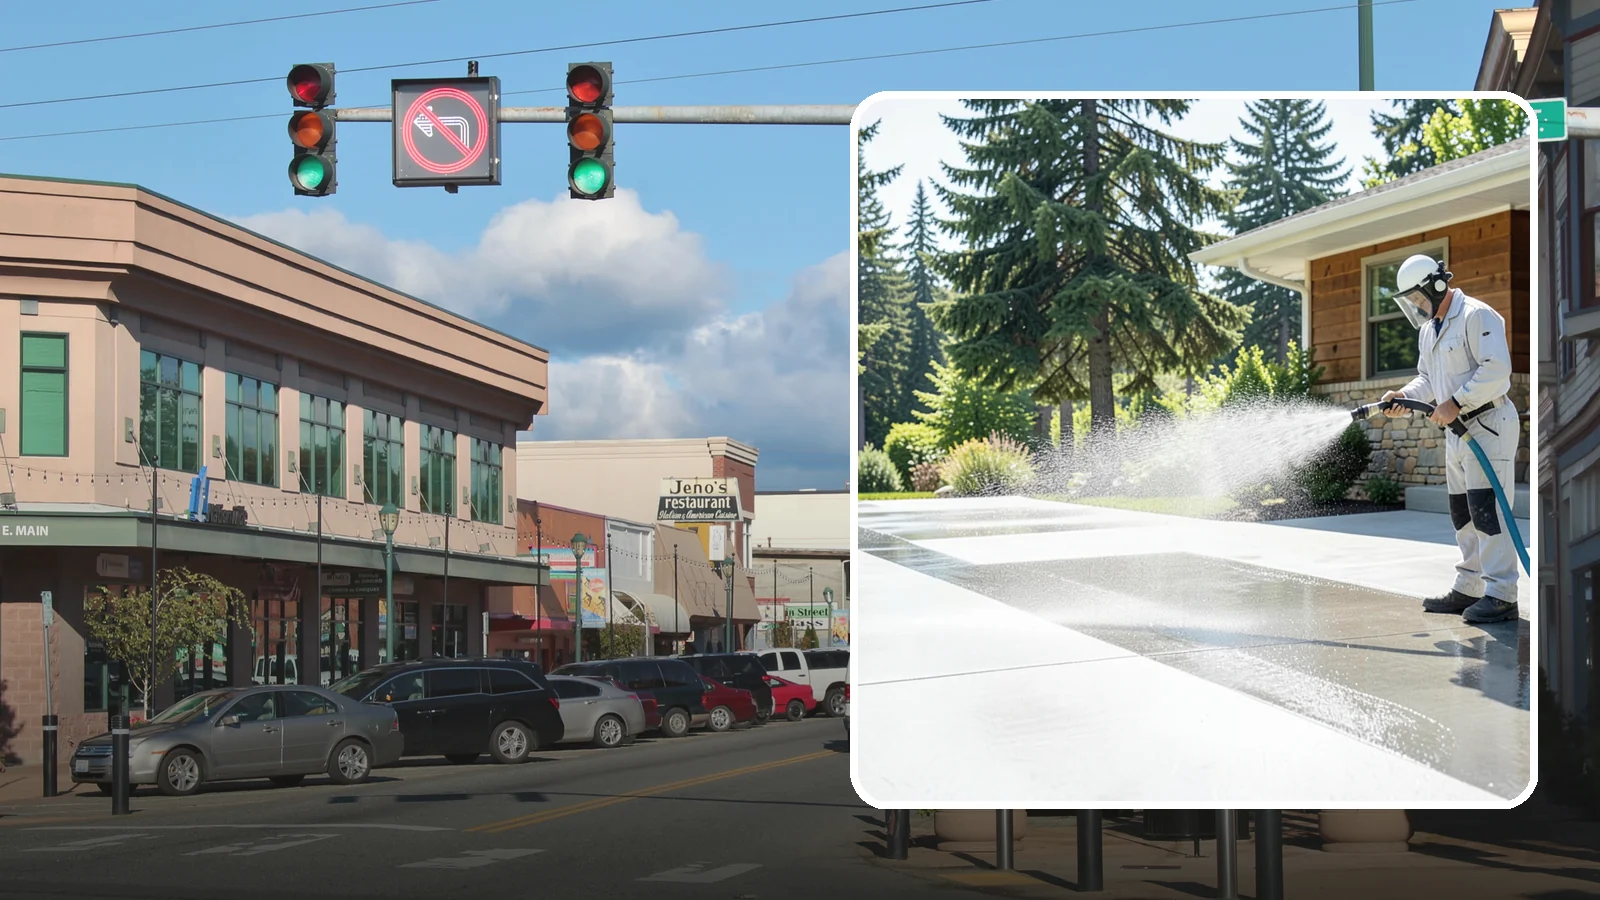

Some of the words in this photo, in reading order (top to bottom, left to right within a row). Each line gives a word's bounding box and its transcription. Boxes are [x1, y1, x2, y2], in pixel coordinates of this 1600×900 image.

[670, 480, 727, 494] Jeno's
[665, 496, 731, 509] restaurant
[658, 510, 682, 519] Italian
[686, 510, 714, 519] American
[715, 509, 737, 518] Cuisine
[2, 525, 13, 536] E.
[16, 525, 49, 537] MAIN
[797, 607, 828, 617] Street
[791, 619, 823, 628] lass
